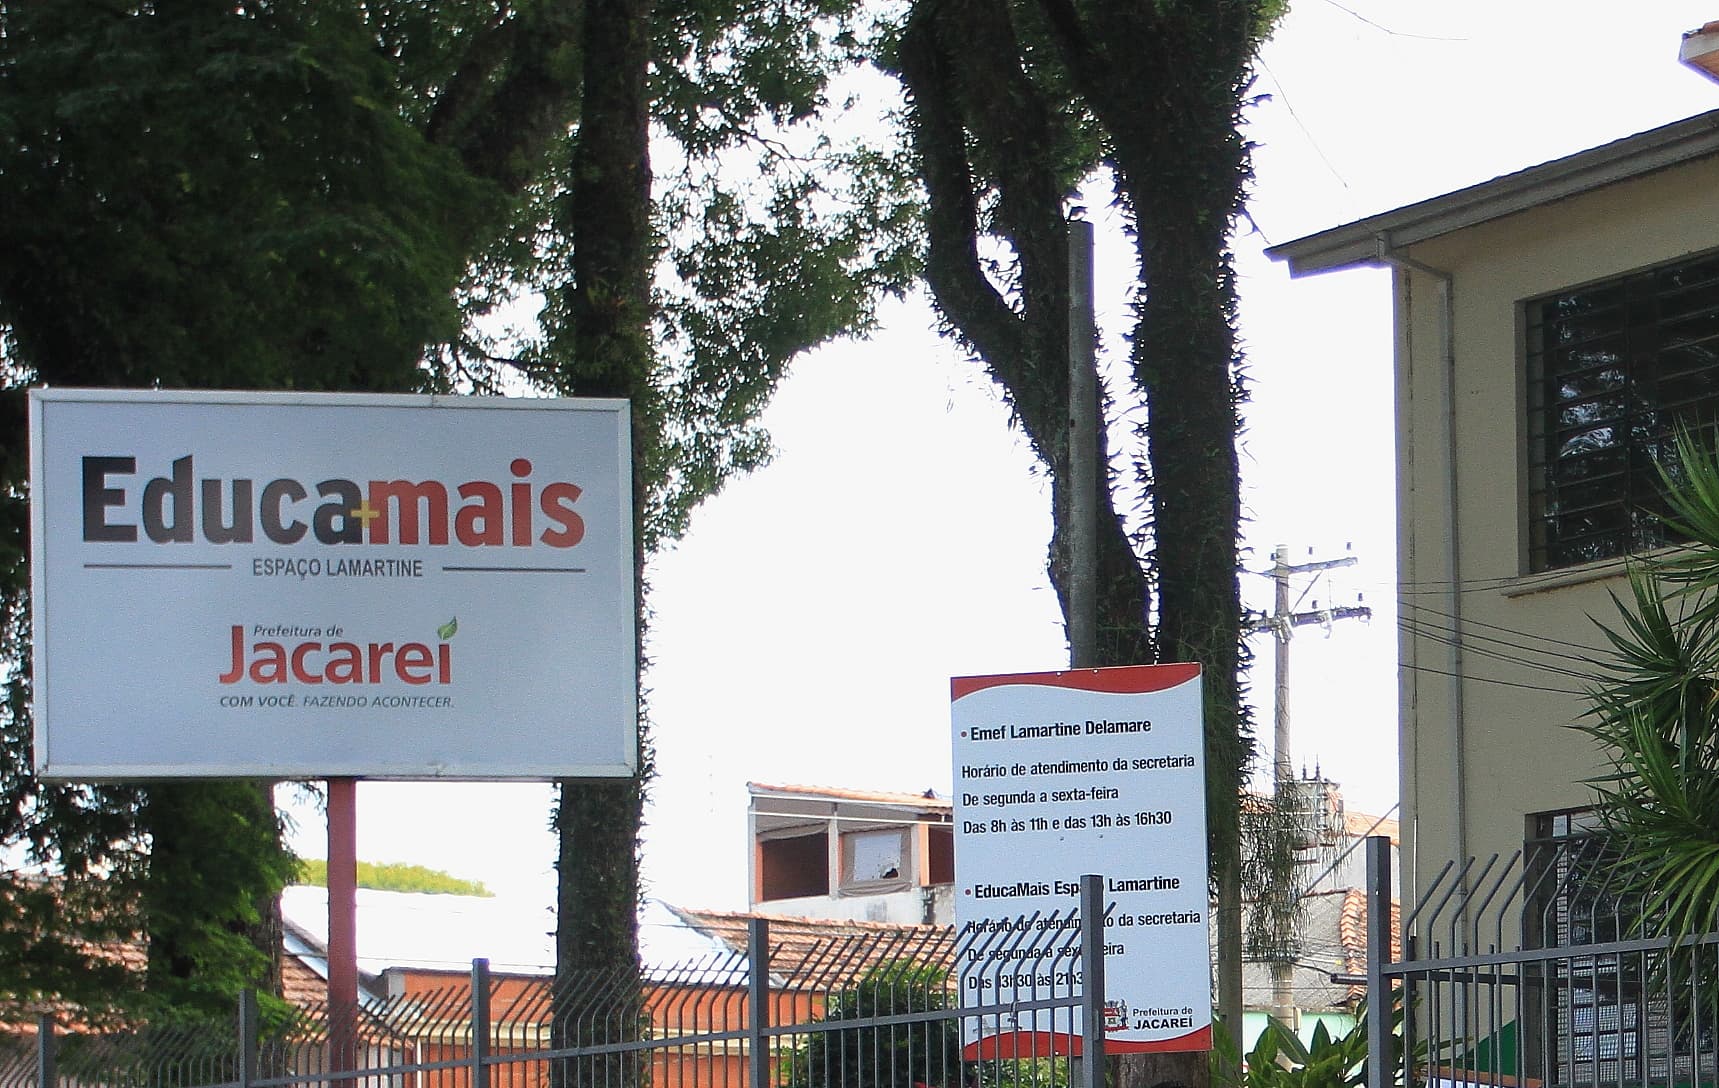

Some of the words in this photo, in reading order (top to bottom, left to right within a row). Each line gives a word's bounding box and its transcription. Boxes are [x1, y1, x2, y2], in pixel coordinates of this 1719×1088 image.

[253, 558, 321, 580] ESPAÇO
[327, 559, 423, 577] LAMARTINE
[253, 624, 322, 637] Prefeitura
[326, 624, 344, 637] de
[220, 695, 253, 708] COM
[303, 695, 367, 708] FAZENDO
[371, 695, 455, 708] ACONTECER.
[970, 726, 1006, 741] Emef
[1011, 722, 1080, 739] Lamartine
[1085, 720, 1151, 735] Delamare
[962, 764, 1006, 778] Horário
[1011, 762, 1026, 776] de
[1031, 759, 1108, 775] atendimento
[1113, 757, 1128, 771] da
[1132, 754, 1195, 769] secretaria
[963, 793, 979, 806] De
[983, 790, 1035, 807] segunda
[1040, 793, 1048, 802] a
[1051, 786, 1119, 802] sexta-feira
[963, 820, 987, 834] Das
[991, 819, 1007, 832] 8h
[1011, 818, 1026, 831] às
[1030, 817, 1048, 831] 11h
[1052, 820, 1060, 830] e
[1064, 816, 1086, 829] das
[1090, 814, 1111, 828] 13h
[1116, 812, 1131, 826] às
[1135, 811, 1172, 825] 16h30
[975, 882, 1050, 899] EducaMais
[1109, 875, 1180, 892] Lamartine
[1118, 913, 1133, 927] da
[1138, 910, 1200, 926] secretaria
[1133, 1006, 1179, 1018] Prefeitura
[1181, 1005, 1193, 1016] de
[1134, 1014, 1193, 1030] JACAREÍ
